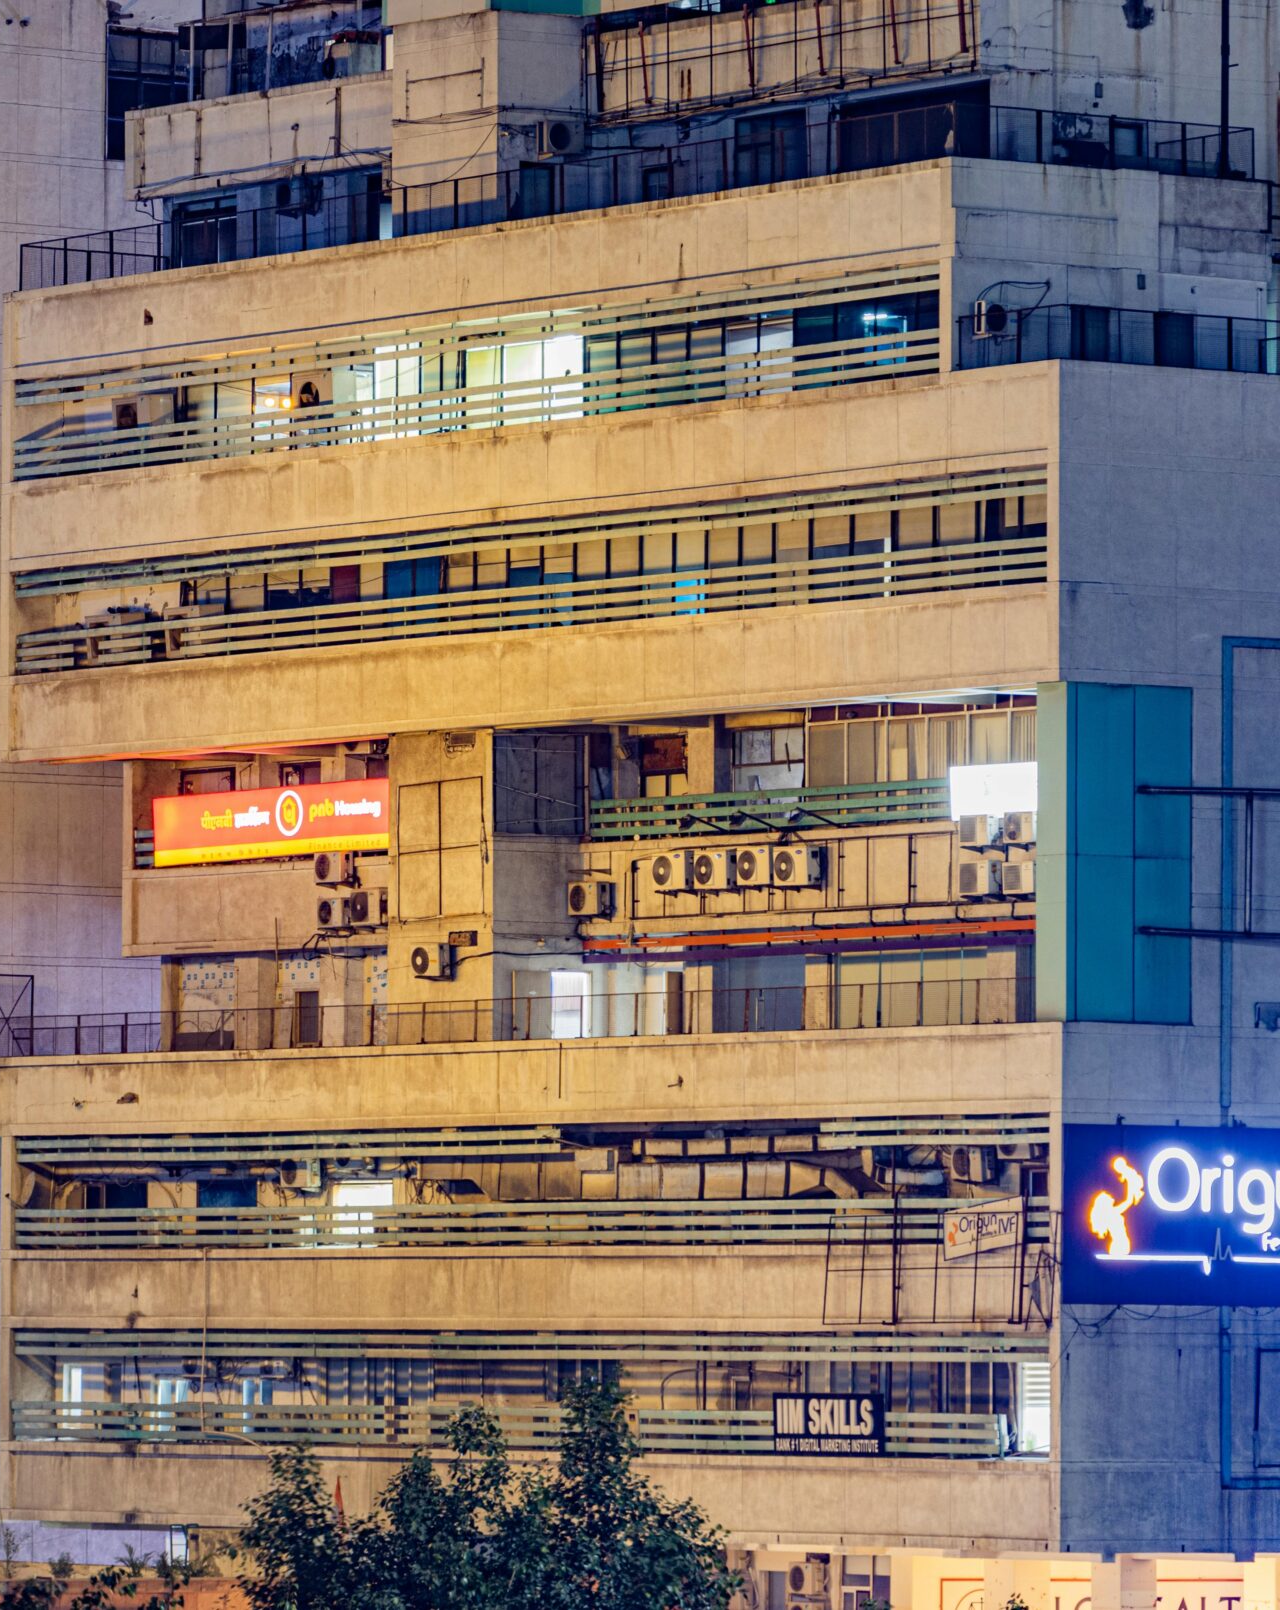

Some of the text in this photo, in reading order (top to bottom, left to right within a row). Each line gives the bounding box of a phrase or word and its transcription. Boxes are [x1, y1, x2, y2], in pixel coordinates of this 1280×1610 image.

[309, 798, 381, 822] pnb Housing
[1147, 1147, 1280, 1234] Orig
[959, 1214, 1015, 1234] Origyn IVF
[776, 1398, 874, 1435] IIM SKILLS
[776, 1438, 791, 1451] RANK
[800, 1438, 820, 1452] DIGITAL
[820, 1439, 851, 1453] MARKETING
[851, 1440, 879, 1453] INSTITUTE
